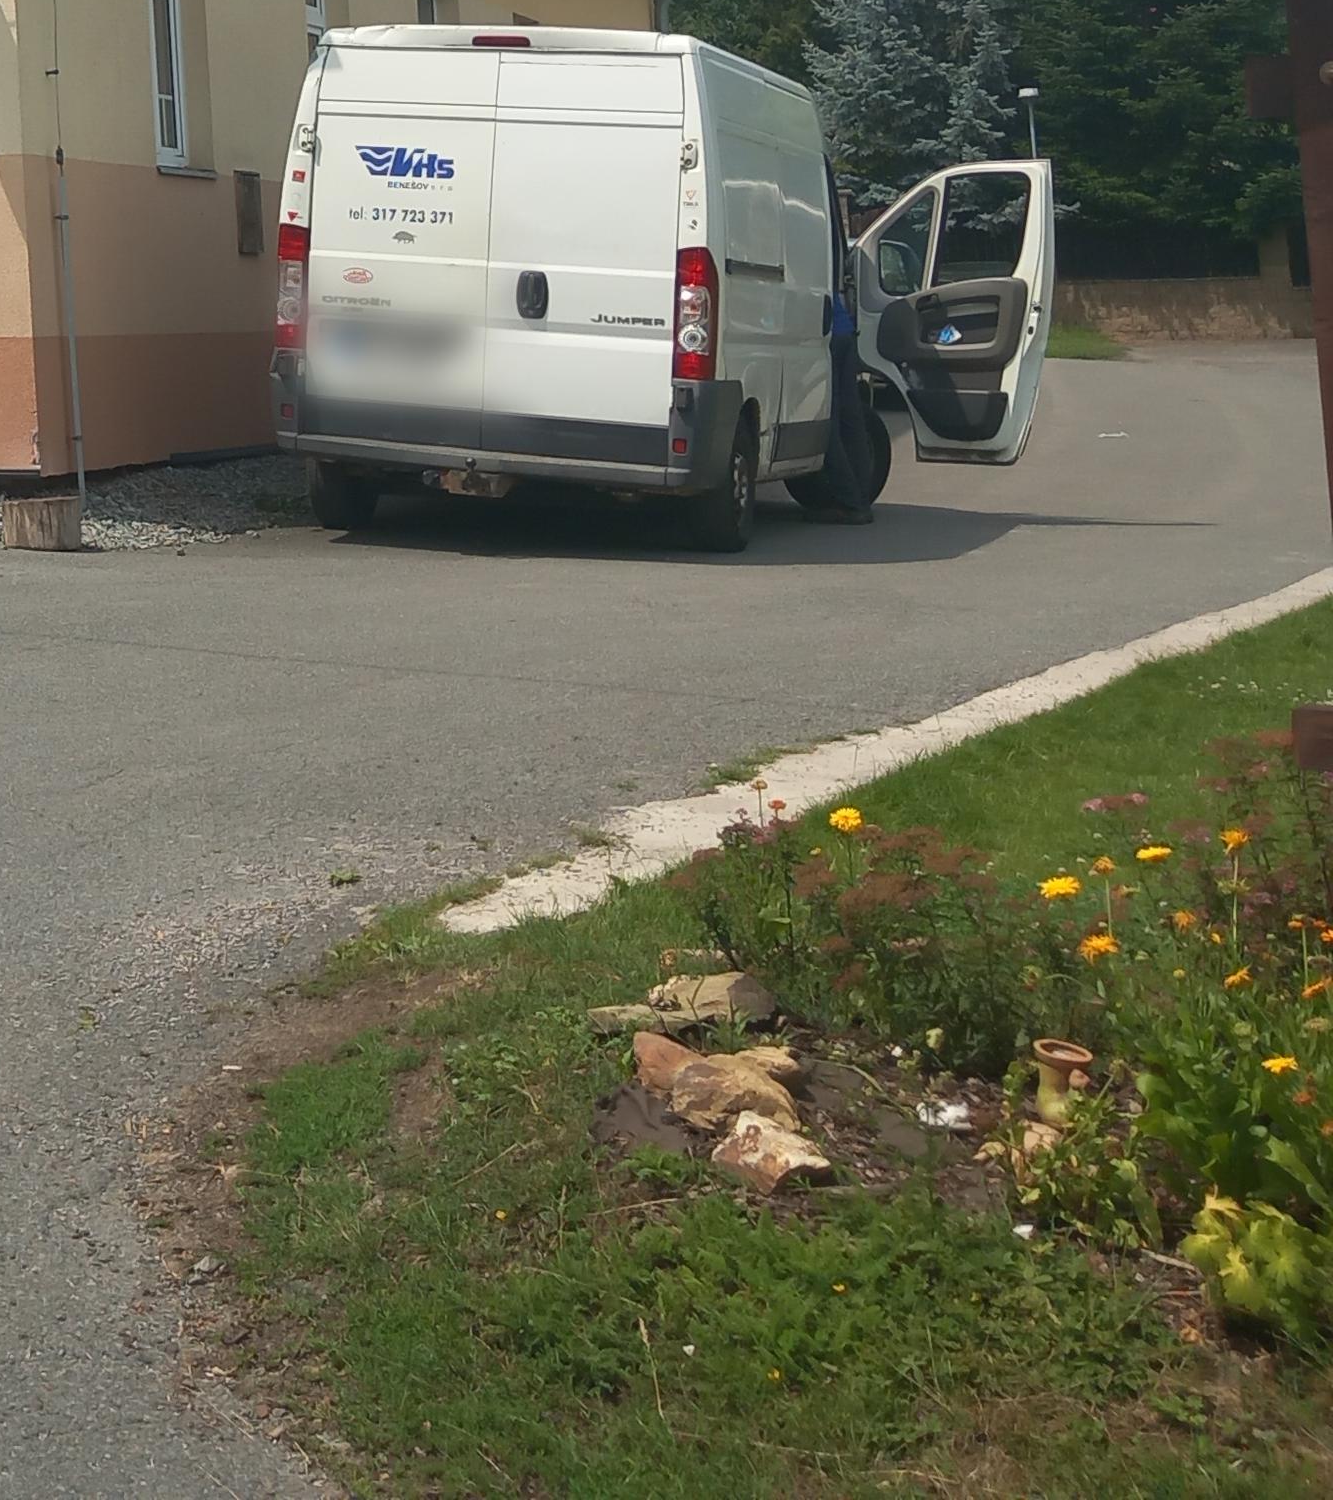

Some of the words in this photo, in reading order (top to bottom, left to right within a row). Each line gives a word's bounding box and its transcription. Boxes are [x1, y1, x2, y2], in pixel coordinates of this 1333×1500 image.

[387, 181, 429, 190] BENEŠOV
[372, 207, 397, 221] 317
[401, 209, 426, 223] 723
[430, 211, 454, 225] 371
[590, 313, 665, 327] JUMPER
